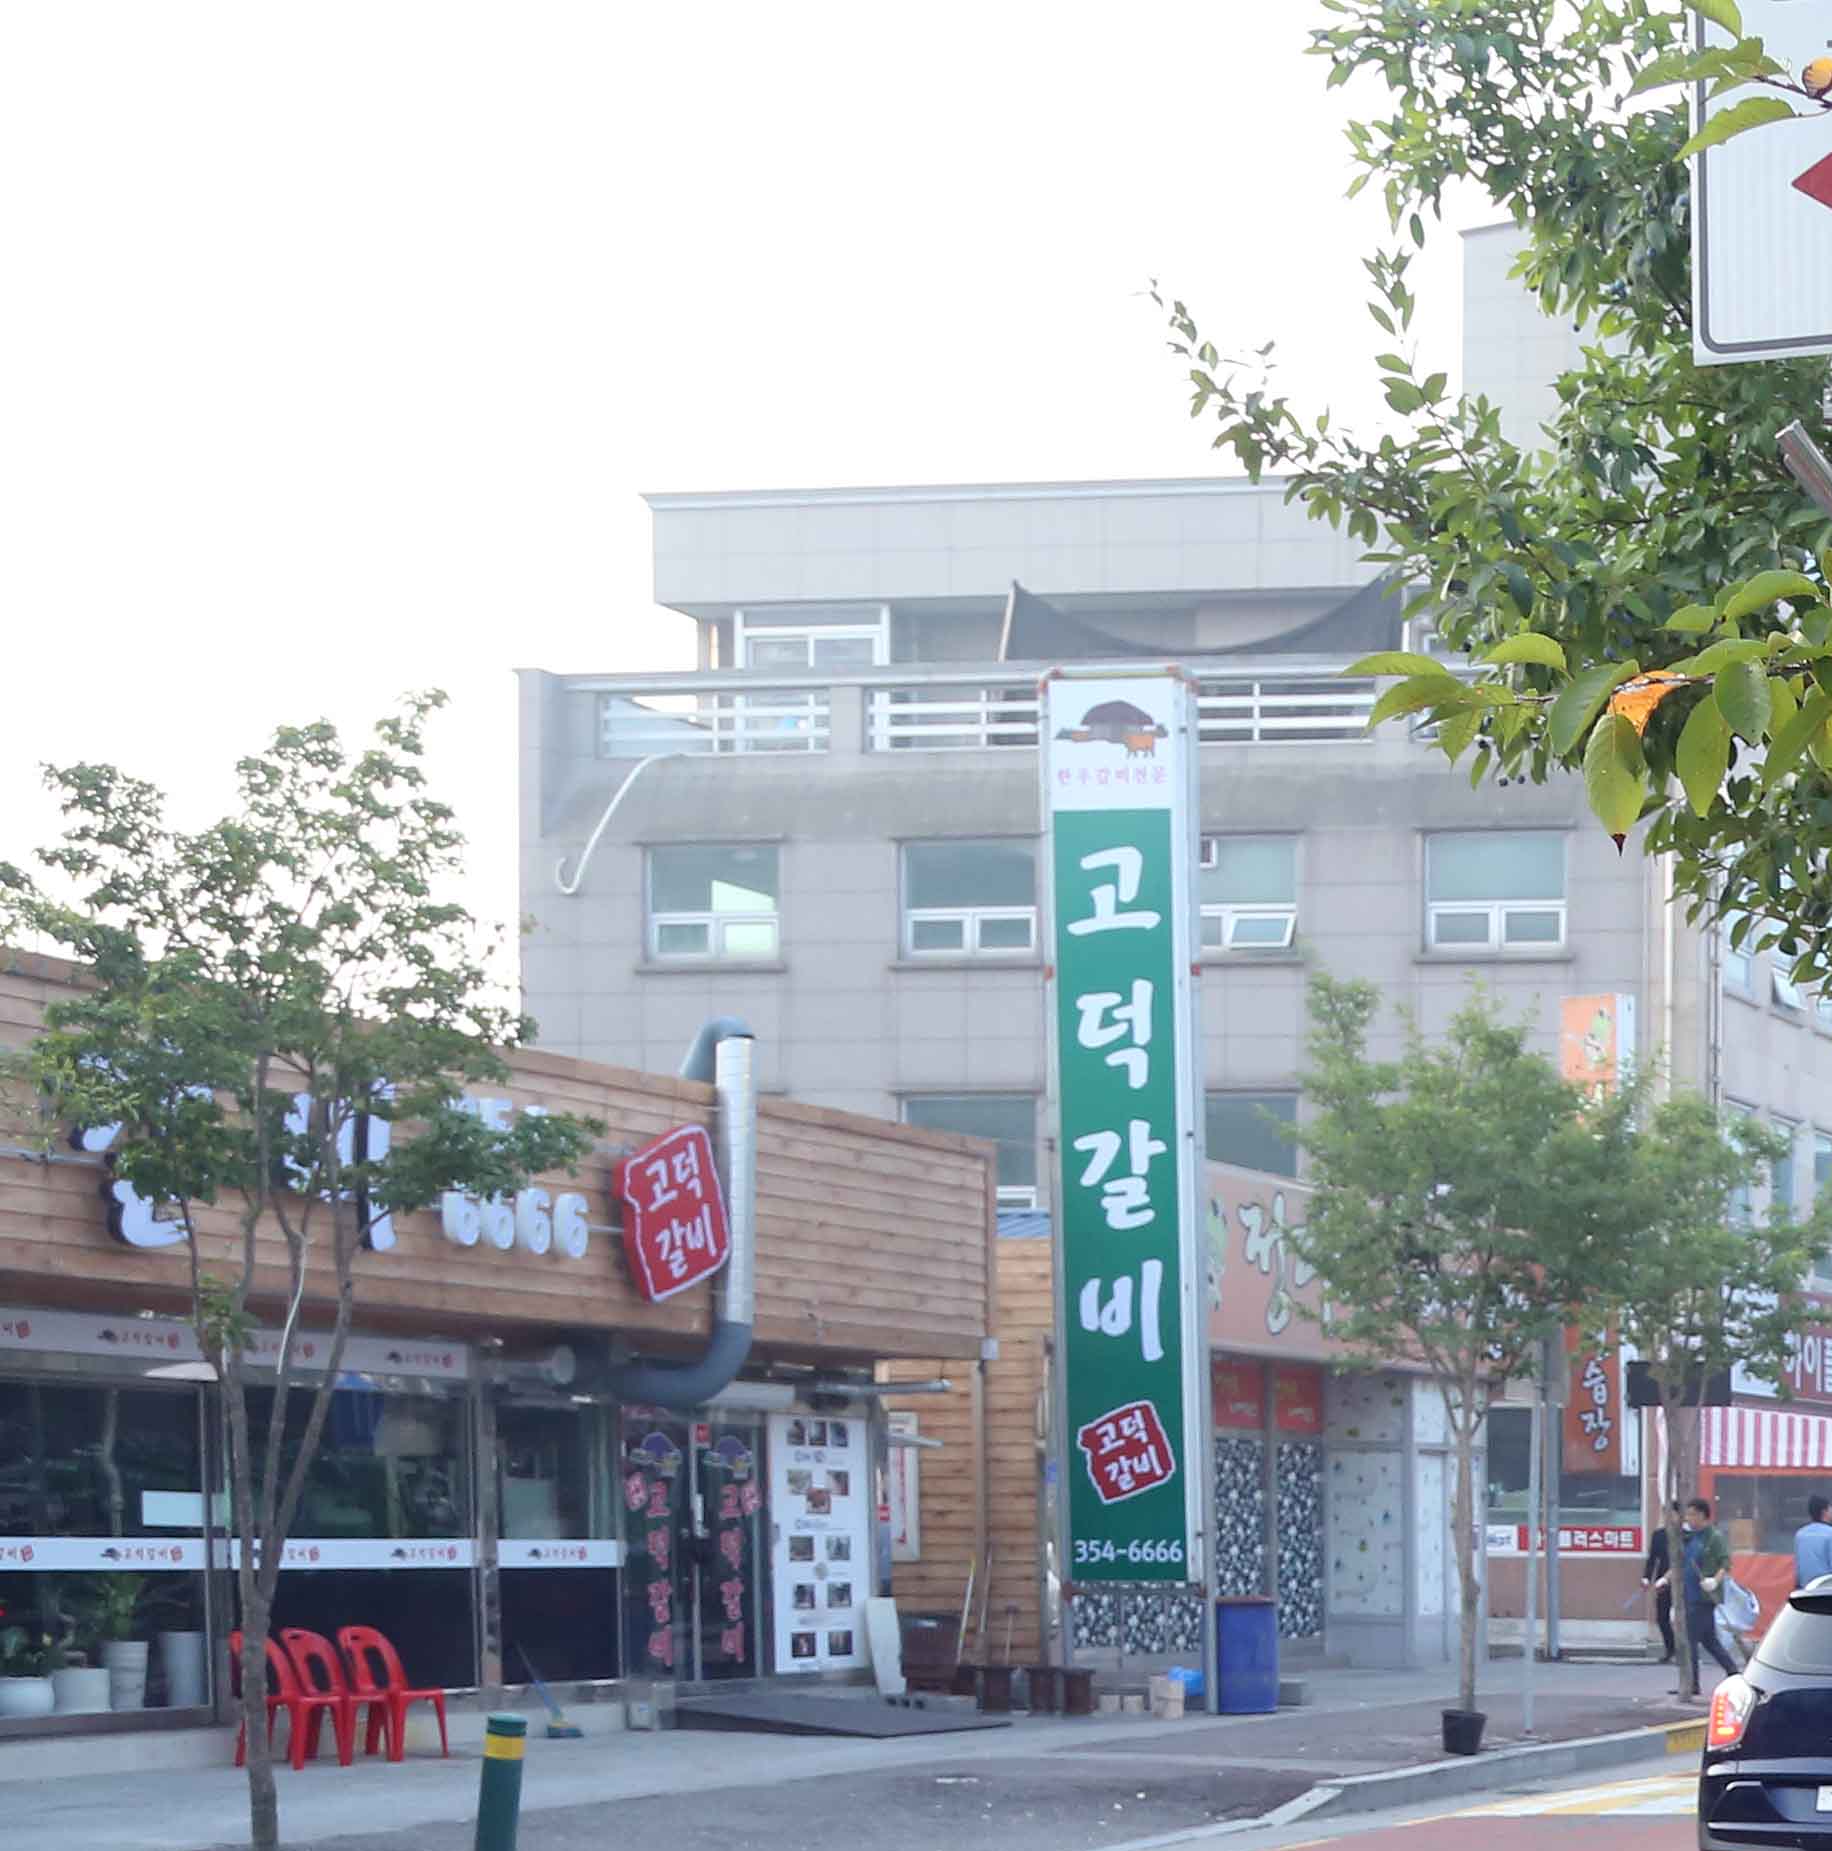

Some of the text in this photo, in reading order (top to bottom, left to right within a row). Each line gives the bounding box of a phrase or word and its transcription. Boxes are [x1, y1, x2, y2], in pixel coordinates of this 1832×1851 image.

[1067, 845, 1168, 1362] 고덕갈비
[644, 1140, 703, 1212] 고덕
[653, 1202, 718, 1280] 갈비
[1096, 1409, 1149, 1455] 고덕
[1104, 1444, 1164, 1491] 갈비
[1074, 1539, 1184, 1563] 354-6666
